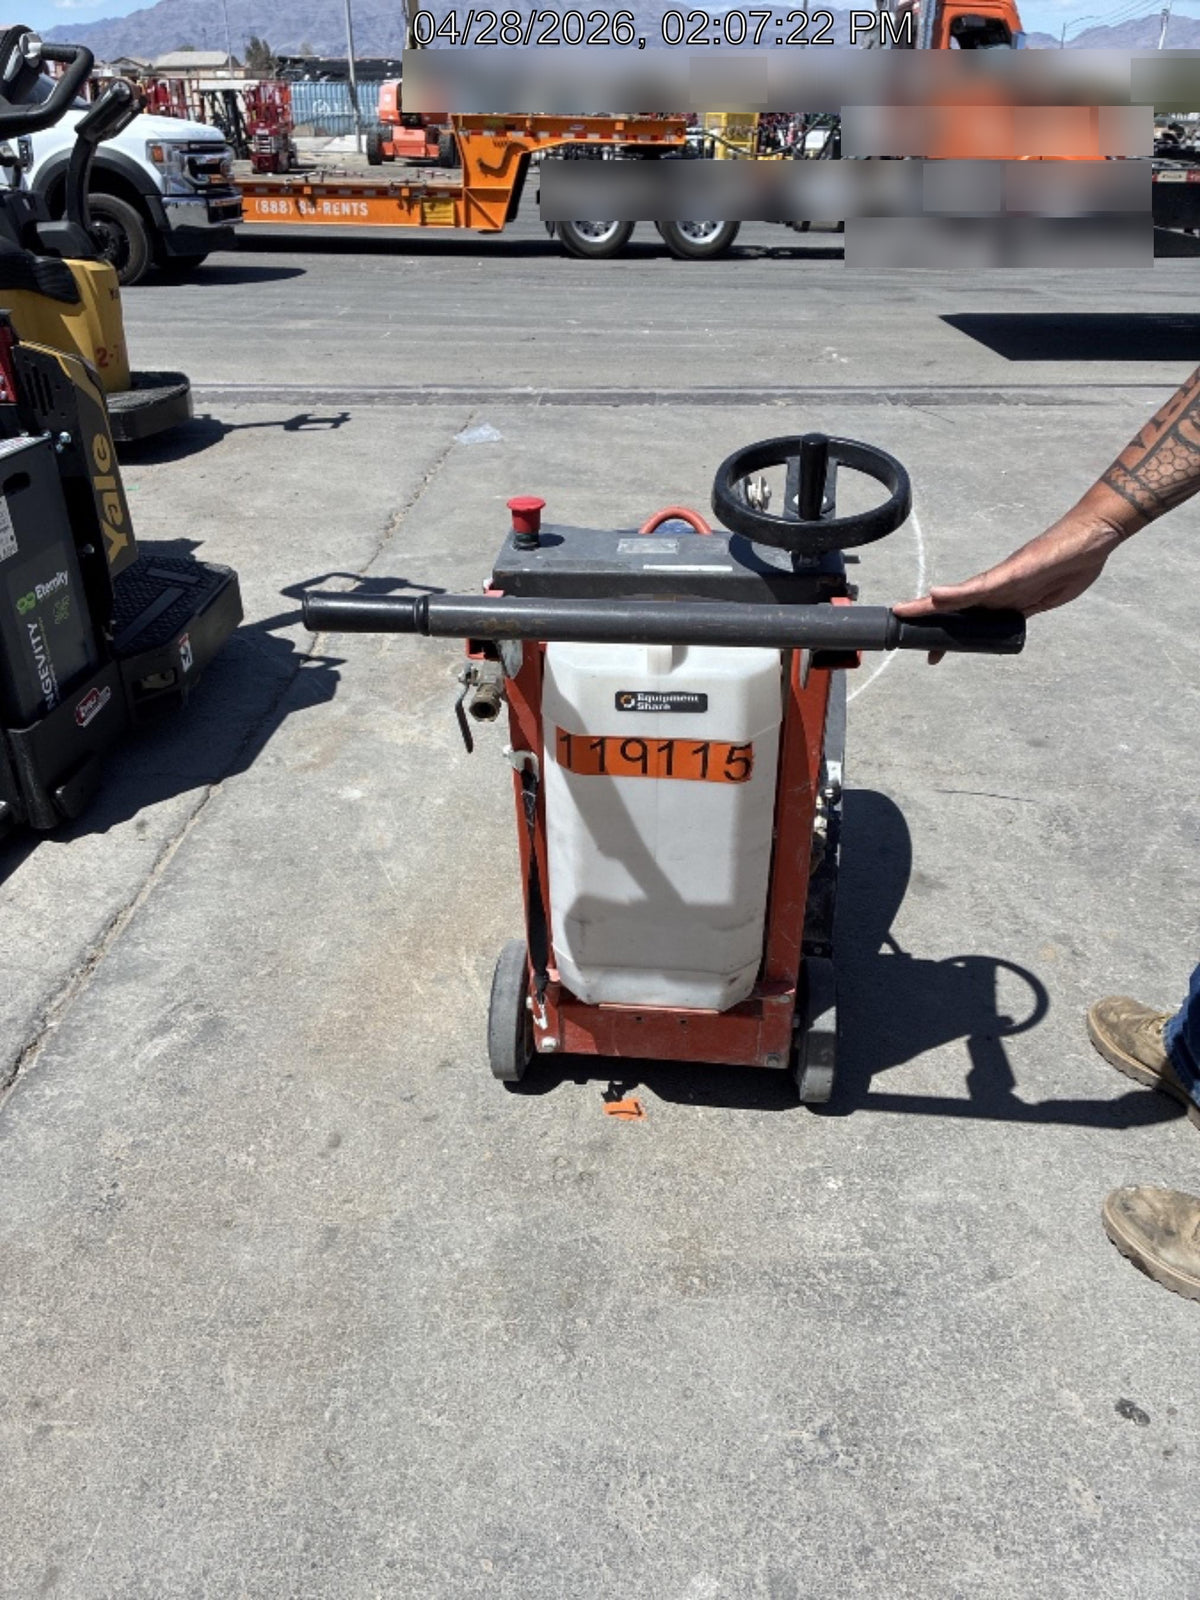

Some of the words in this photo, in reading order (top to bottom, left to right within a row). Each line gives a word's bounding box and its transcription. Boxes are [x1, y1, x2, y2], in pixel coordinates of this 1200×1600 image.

[93, 433, 128, 563] Yale
[35, 569, 69, 600] Eternity
[637, 692, 700, 703] Equipment
[637, 702, 671, 711] Share
[559, 733, 755, 782] 119115
